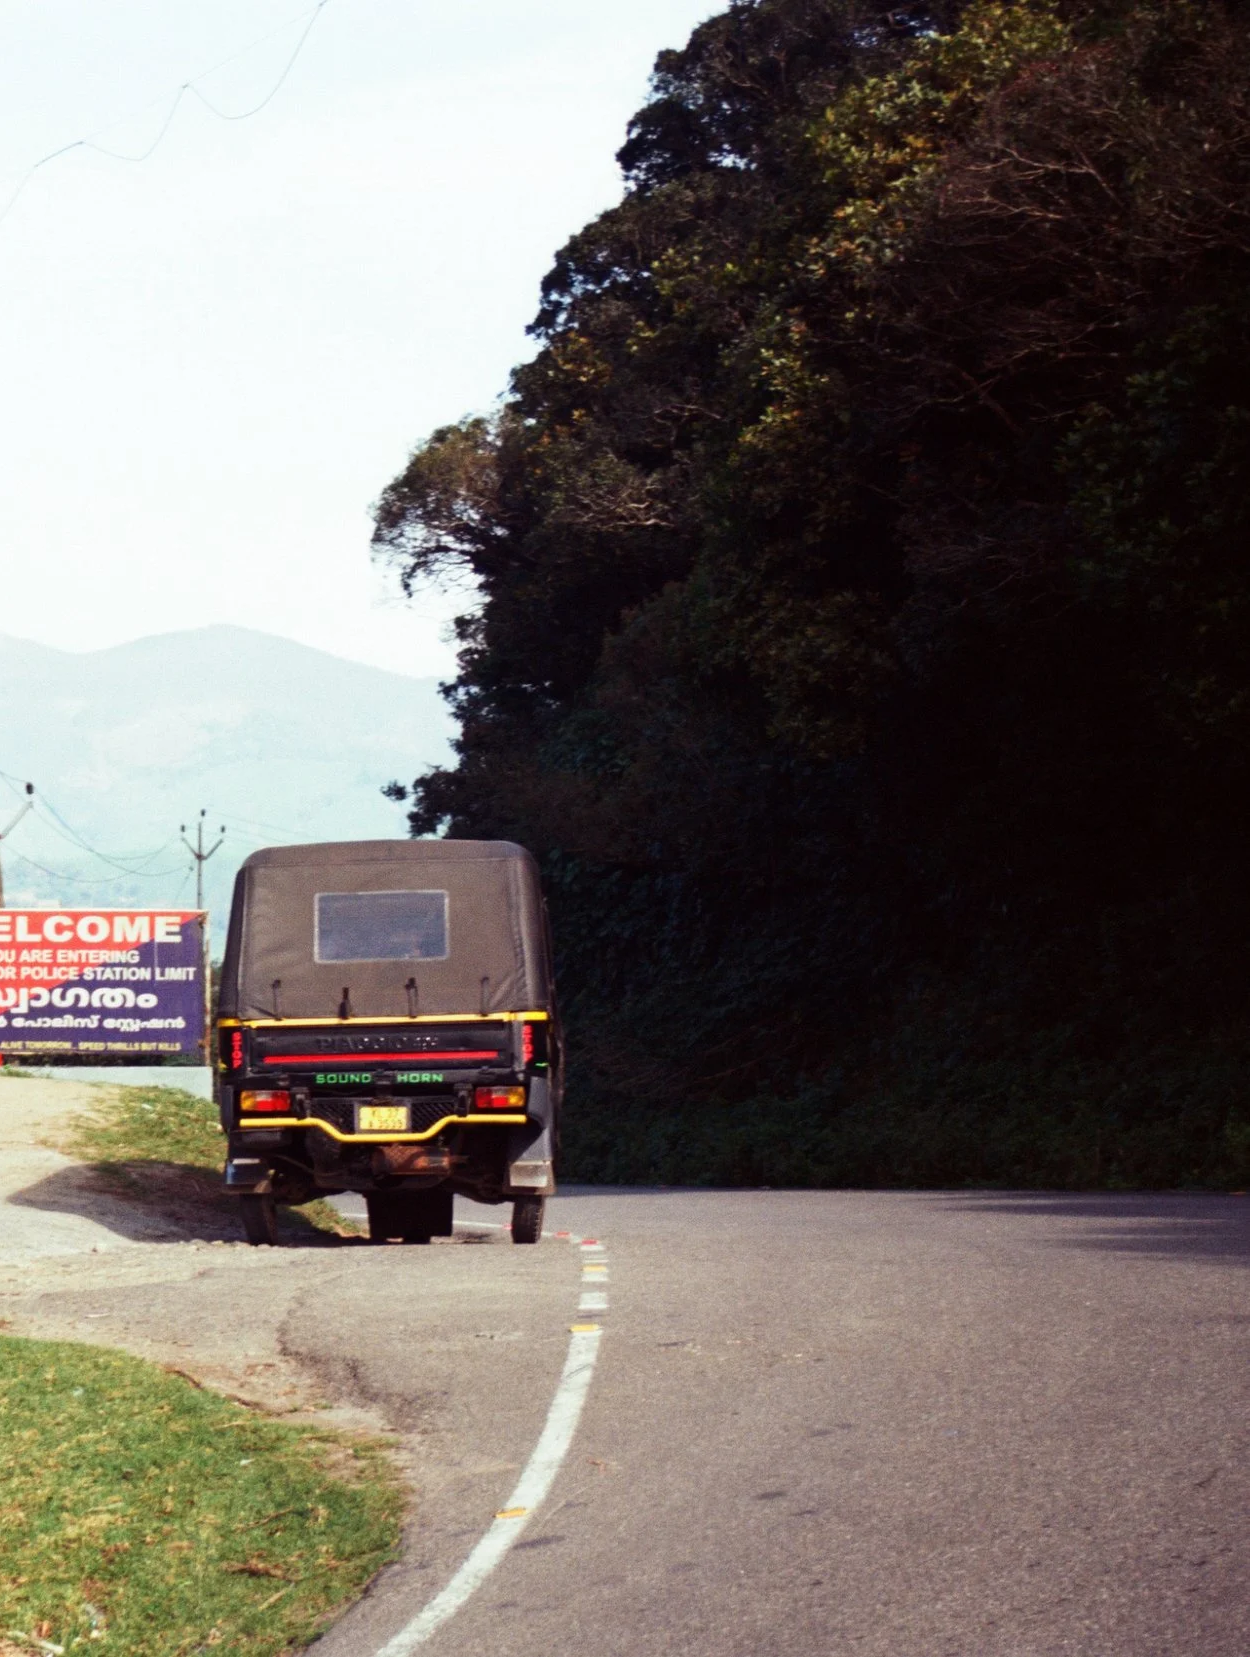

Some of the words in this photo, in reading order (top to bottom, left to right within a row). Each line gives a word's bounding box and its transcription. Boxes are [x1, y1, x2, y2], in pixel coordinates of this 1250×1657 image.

[19, 949, 53, 963] ARE
[56, 949, 140, 964] ENTERING
[20, 966, 81, 981] POLICE
[83, 967, 152, 981] STATION
[155, 967, 196, 981] LIMIT
[0, 1041, 23, 1050] ALIVE
[78, 1041, 105, 1050] SPEED
[141, 1041, 157, 1050] BUT
[315, 1073, 372, 1085] SOUND
[396, 1072, 443, 1084] HORN
